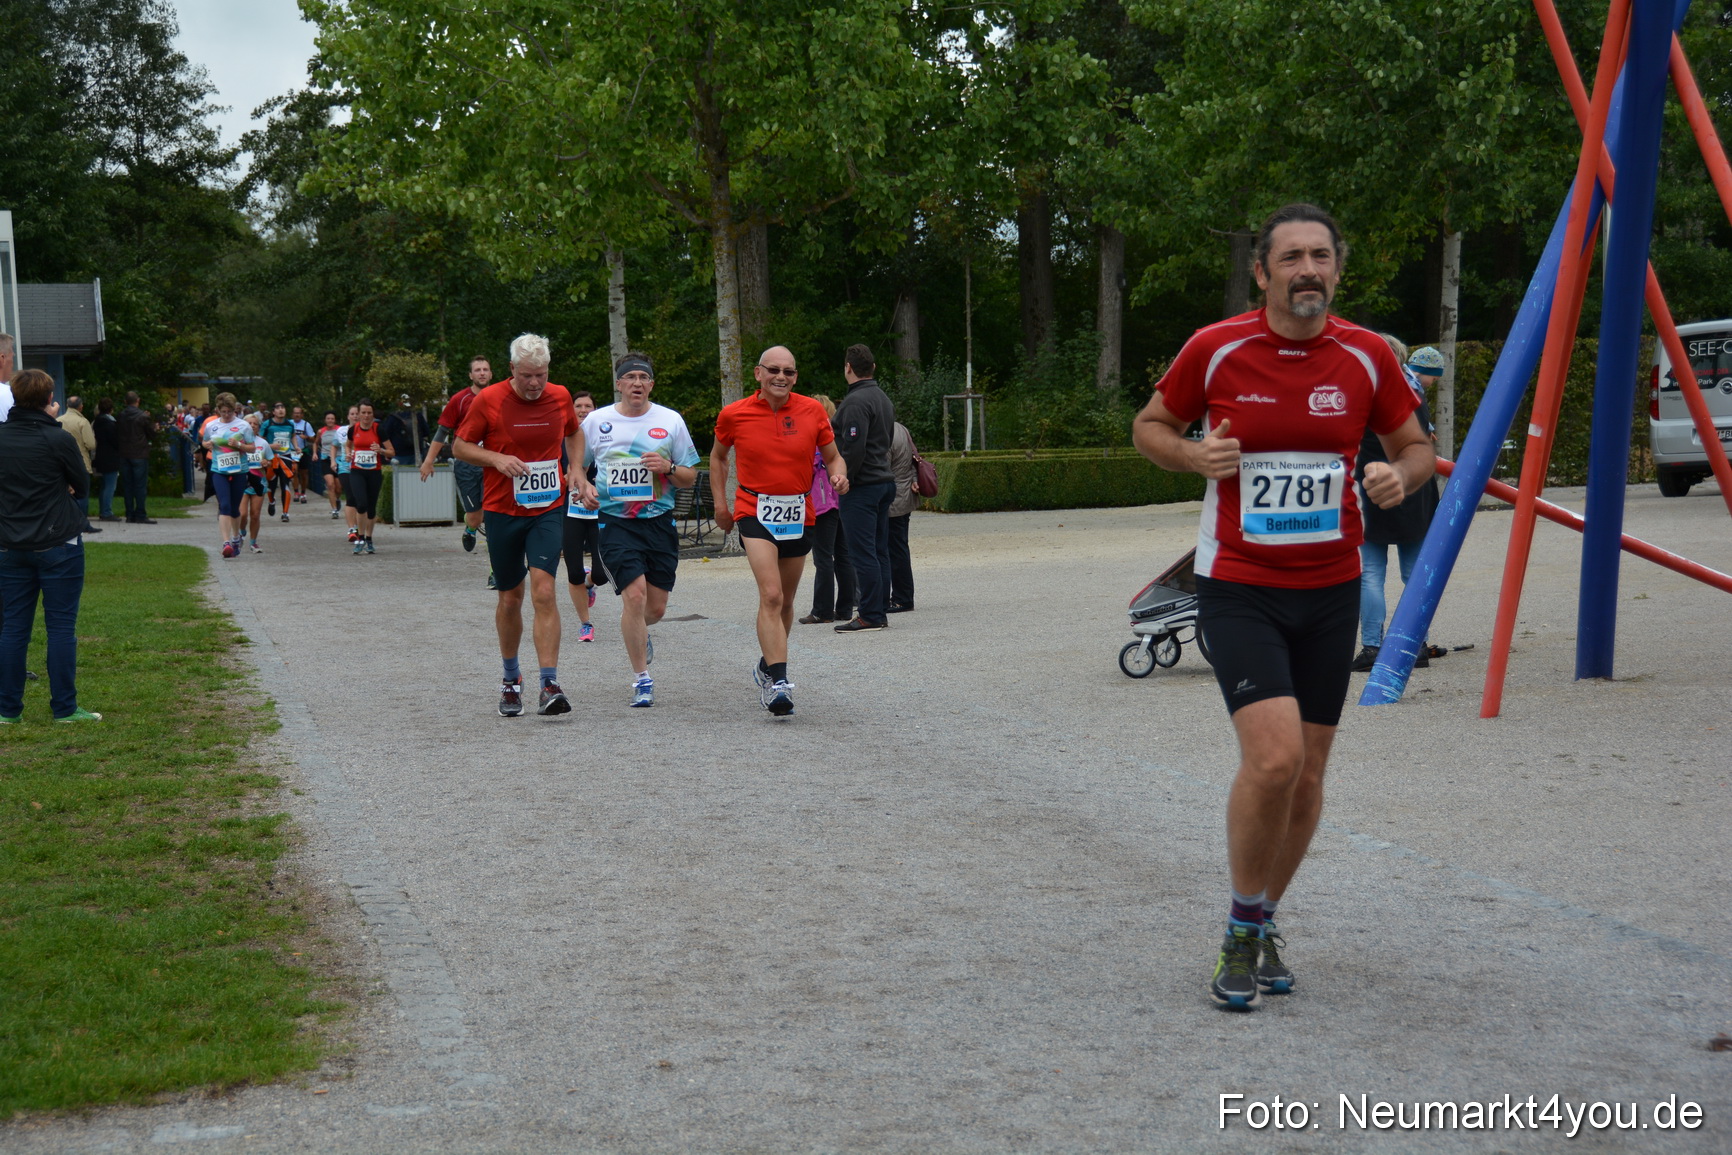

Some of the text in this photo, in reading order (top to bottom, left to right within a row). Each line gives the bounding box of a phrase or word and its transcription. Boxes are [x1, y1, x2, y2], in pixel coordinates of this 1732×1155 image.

[220, 456, 239, 467] 3037
[357, 455, 375, 463] 2041
[1242, 461, 1326, 470] PARTL Neumarkt
[519, 471, 557, 491] 2600
[611, 468, 649, 485] 2402
[620, 488, 638, 496] Erwin
[1252, 473, 1331, 508] 2781
[762, 505, 801, 522] 2245
[1266, 515, 1320, 531] Berthold
[775, 526, 787, 534] Karl
